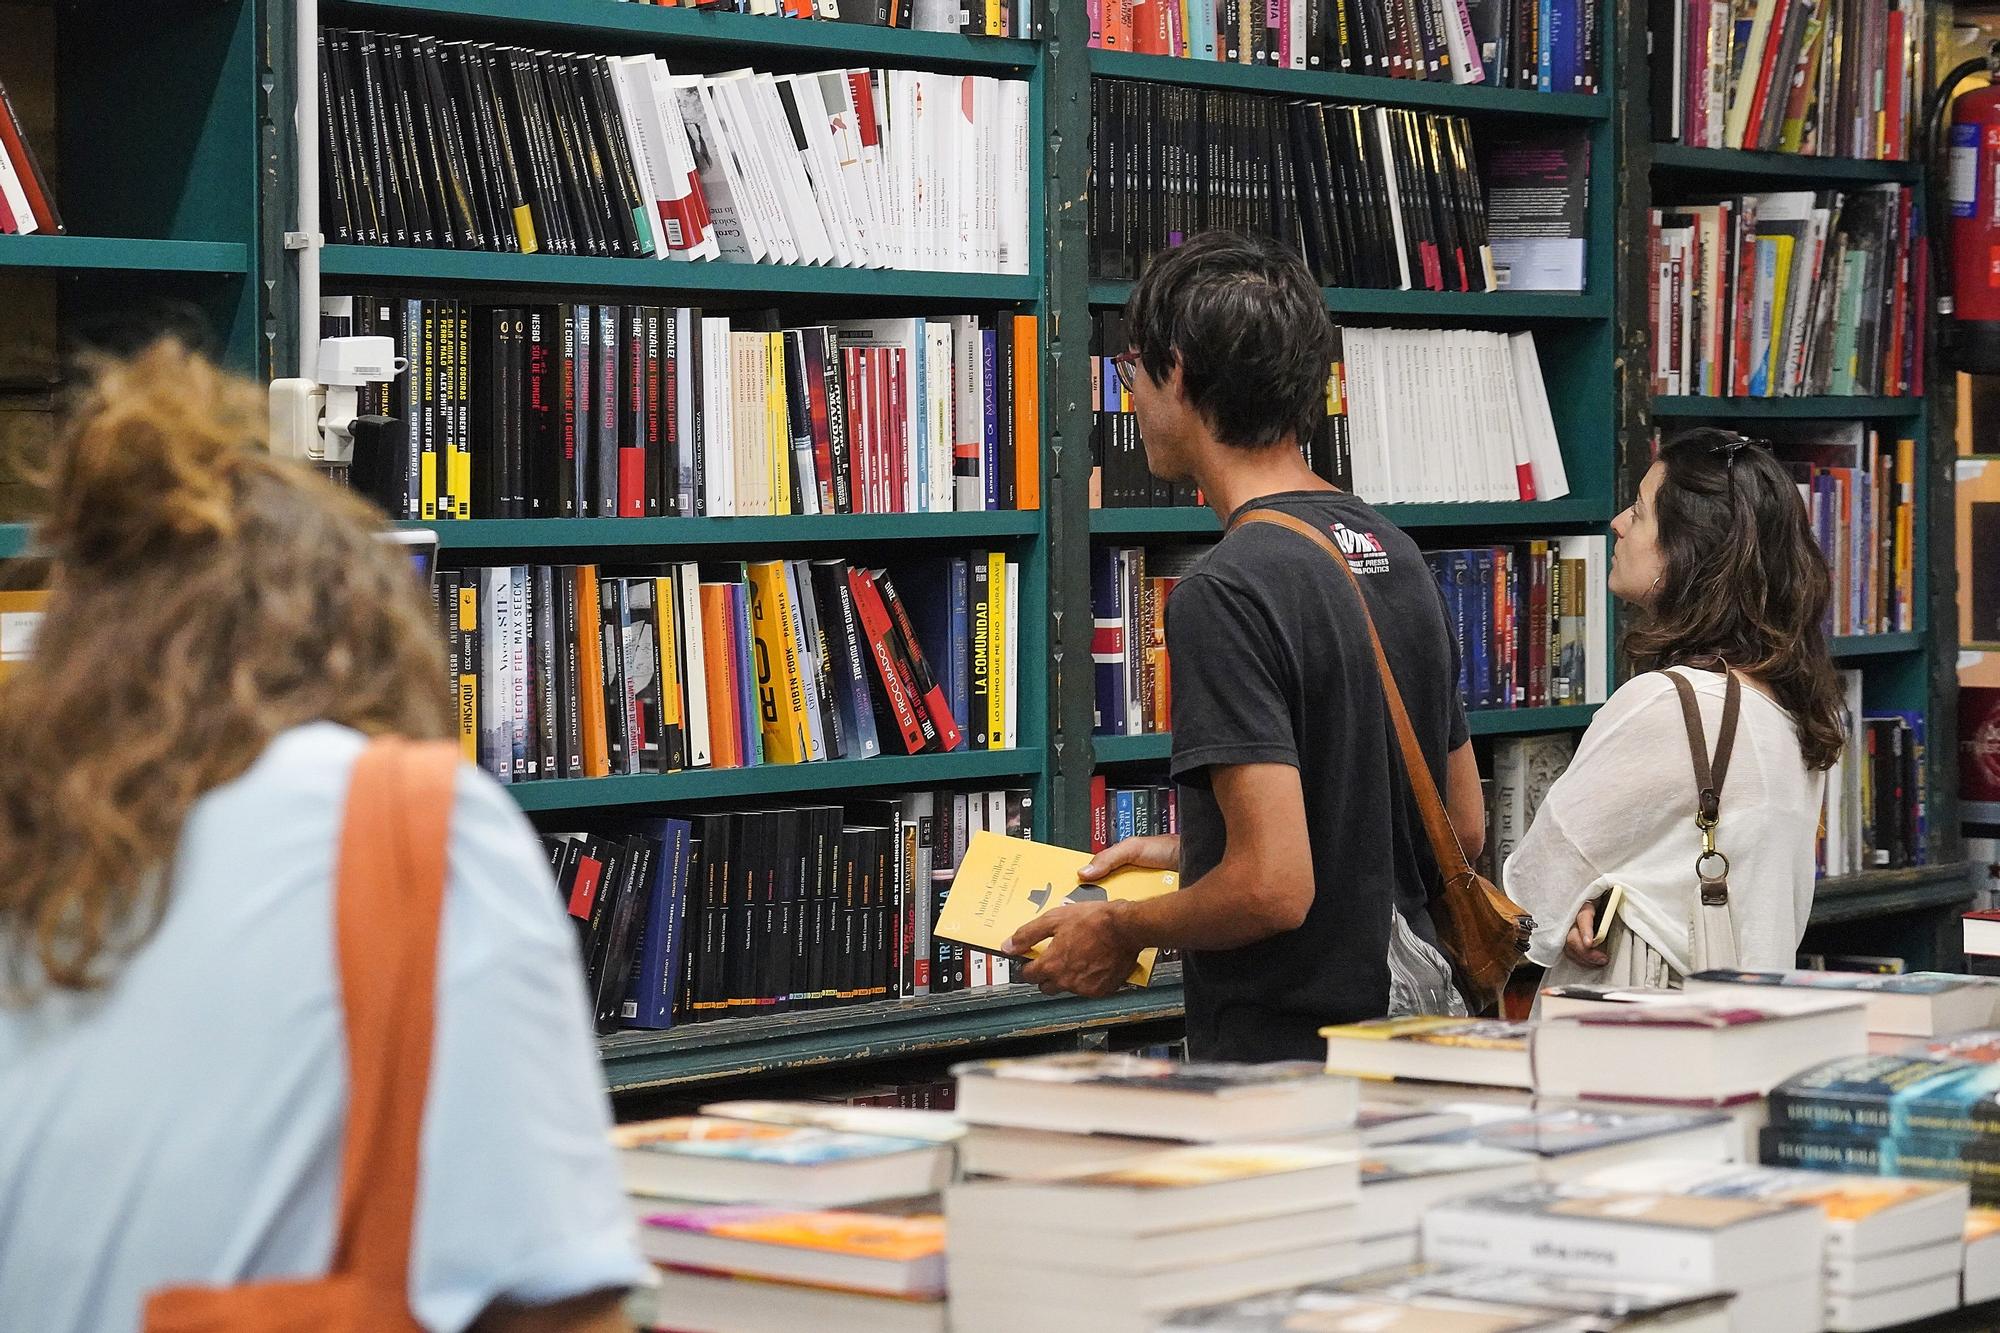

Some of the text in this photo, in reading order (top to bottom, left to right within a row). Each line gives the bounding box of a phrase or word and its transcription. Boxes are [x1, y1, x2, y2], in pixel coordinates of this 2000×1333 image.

[582, 318, 590, 346] HORST
[632, 318, 642, 337] DÍAZ
[410, 332, 418, 356] NOCHE
[532, 314, 540, 409] NESBØ SOL DE SANGRE
[668, 360, 675, 372] UN
[410, 376, 418, 405] OSCURA
[565, 318, 573, 459] LE CORRE DESPUÉS DE LA GUERRA
[650, 318, 658, 442] GONZÁLEZ UN TRABAJO LIMPIO
[985, 347, 993, 416] MAJESTAD
[410, 412, 418, 440] ROBERT
[606, 397, 614, 428] CELOSO
[410, 443, 418, 477] BRYNDZA
[1366, 558, 1389, 566] PRESES
[840, 585, 852, 622] ASESINATO
[884, 582, 896, 601] DÍAZ
[450, 584, 458, 694] MUY NEGRO ANTONIO LOZANO
[846, 624, 854, 632] DE
[848, 634, 856, 644] UN
[514, 582, 523, 738] EL LECTOR FIEL MAX SEECK
[778, 592, 802, 712] ROBIN COOK PANDEMIA
[974, 602, 987, 694] LA COMUNIDAD
[994, 644, 1000, 656] ME
[544, 640, 552, 738] La MEMORIA del TEJO
[876, 641, 913, 726] EL PROCURADOR
[462, 684, 473, 734] #FINSAQUÍ
[994, 712, 1000, 722] LO
[922, 720, 936, 740] DÍAZ
[551, 848, 559, 864] Siruela
[570, 848, 578, 864] Siruela
[606, 858, 616, 879] ANTONIO
[894, 884, 900, 893] TE
[894, 895, 900, 905] NO
[975, 857, 1006, 916] Andrea Camilleri
[984, 918, 994, 928] El
